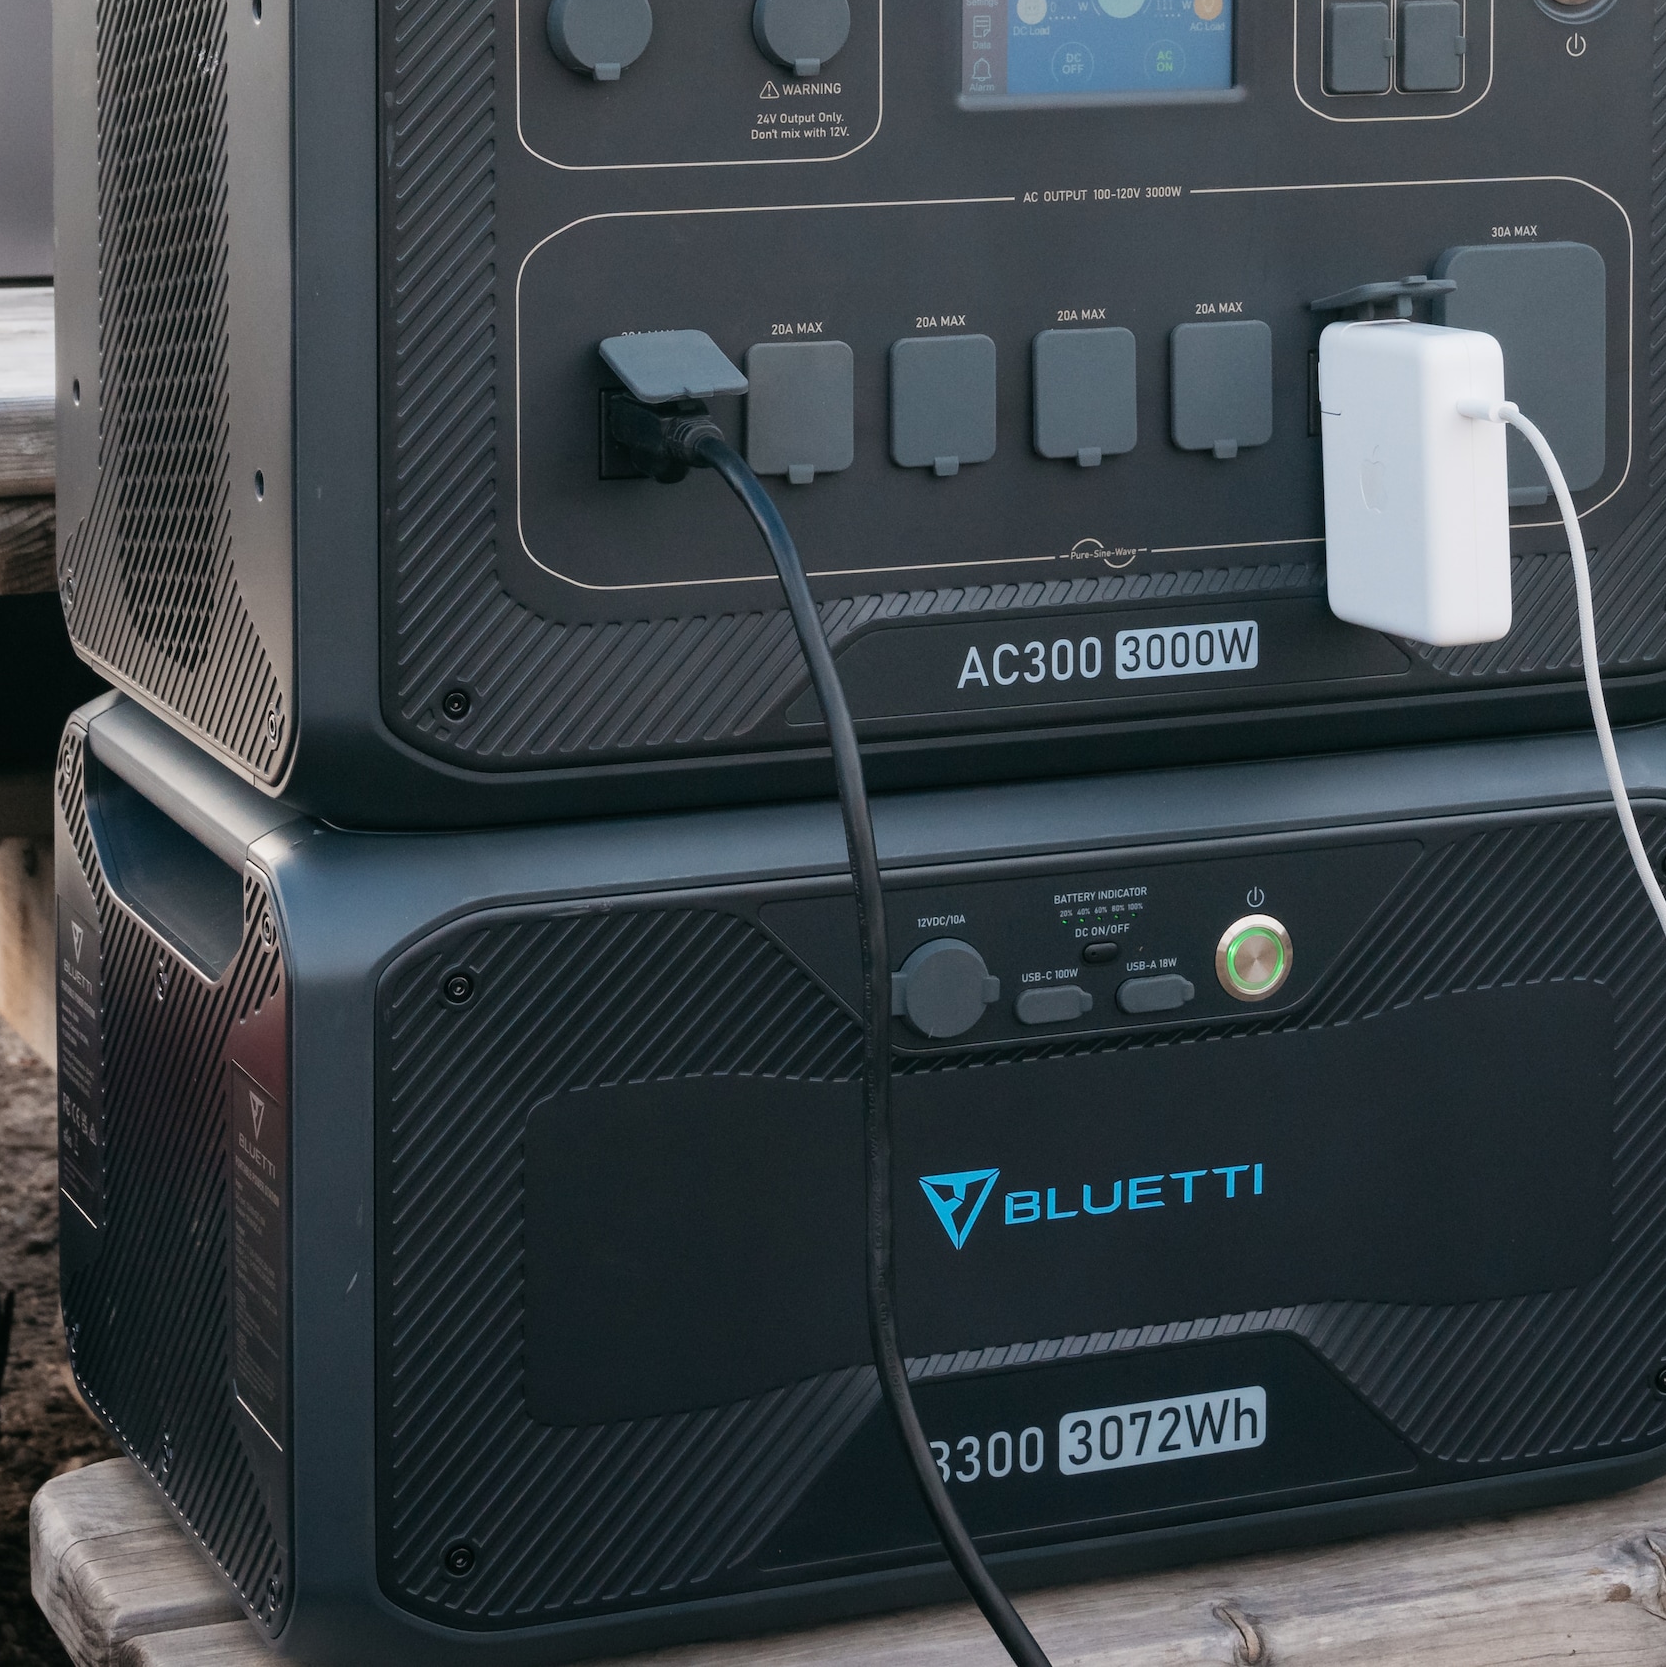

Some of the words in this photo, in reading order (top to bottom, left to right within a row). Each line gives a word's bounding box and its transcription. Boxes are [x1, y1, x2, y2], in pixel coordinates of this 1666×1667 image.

[1078, 2, 1090, 12] W
[1182, 0, 1193, 10] W
[1013, 26, 1028, 36] DC
[1030, 25, 1050, 36] Load
[1190, 22, 1204, 32] AC
[1205, 22, 1225, 32] Load
[972, 40, 991, 50] Data
[1066, 53, 1082, 63] DC
[1156, 51, 1173, 61] AC
[1062, 64, 1085, 75] OFF
[1156, 62, 1174, 73] ON
[782, 82, 842, 96] WARNING
[969, 82, 995, 93] Alarm
[757, 113, 777, 124] 24V
[780, 113, 815, 126] Output
[818, 112, 844, 126] Only.
[751, 129, 778, 140] Don't
[781, 128, 800, 140] mix
[802, 127, 826, 139] with
[830, 126, 850, 138] 12V.
[1023, 191, 1039, 203] AC
[1044, 190, 1087, 202] OUTPUT
[1093, 188, 1141, 201] 100-120V
[1145, 186, 1182, 199] 3000W
[1491, 226, 1510, 238] 30A
[1514, 225, 1538, 237] MAX
[1057, 309, 1078, 321] 20A
[1082, 308, 1106, 320] MAX
[1195, 302, 1215, 314] 20A
[1219, 301, 1243, 313] MAX
[915, 316, 937, 328] 20A
[941, 315, 966, 327] MAX
[771, 323, 793, 336] 20A
[797, 322, 823, 334] MAX
[1070, 547, 1137, 561] Pure-Sine-Wave
[957, 635, 1102, 689] AC300
[1121, 627, 1254, 673] 3000W
[1054, 889, 1095, 905] BATTERY
[1097, 886, 1147, 901] INDICATOR
[1059, 909, 1073, 917] 20%
[1077, 908, 1091, 916] 40%
[1094, 906, 1108, 914] 60%
[1111, 904, 1125, 912] 80%
[1127, 902, 1144, 911] 100%
[917, 914, 966, 928] 12VDC/10A
[1075, 927, 1090, 938] DC
[1091, 923, 1130, 937] ON/OFF
[1126, 960, 1157, 972] USB-A
[1159, 957, 1177, 969] 18W
[1021, 971, 1053, 983] USB-C
[1055, 968, 1079, 980] 100W
[238, 1132, 276, 1181] BLUETTI
[1005, 1163, 1263, 1225] BLUETTI
[1068, 1397, 1258, 1466] 3072Wh
